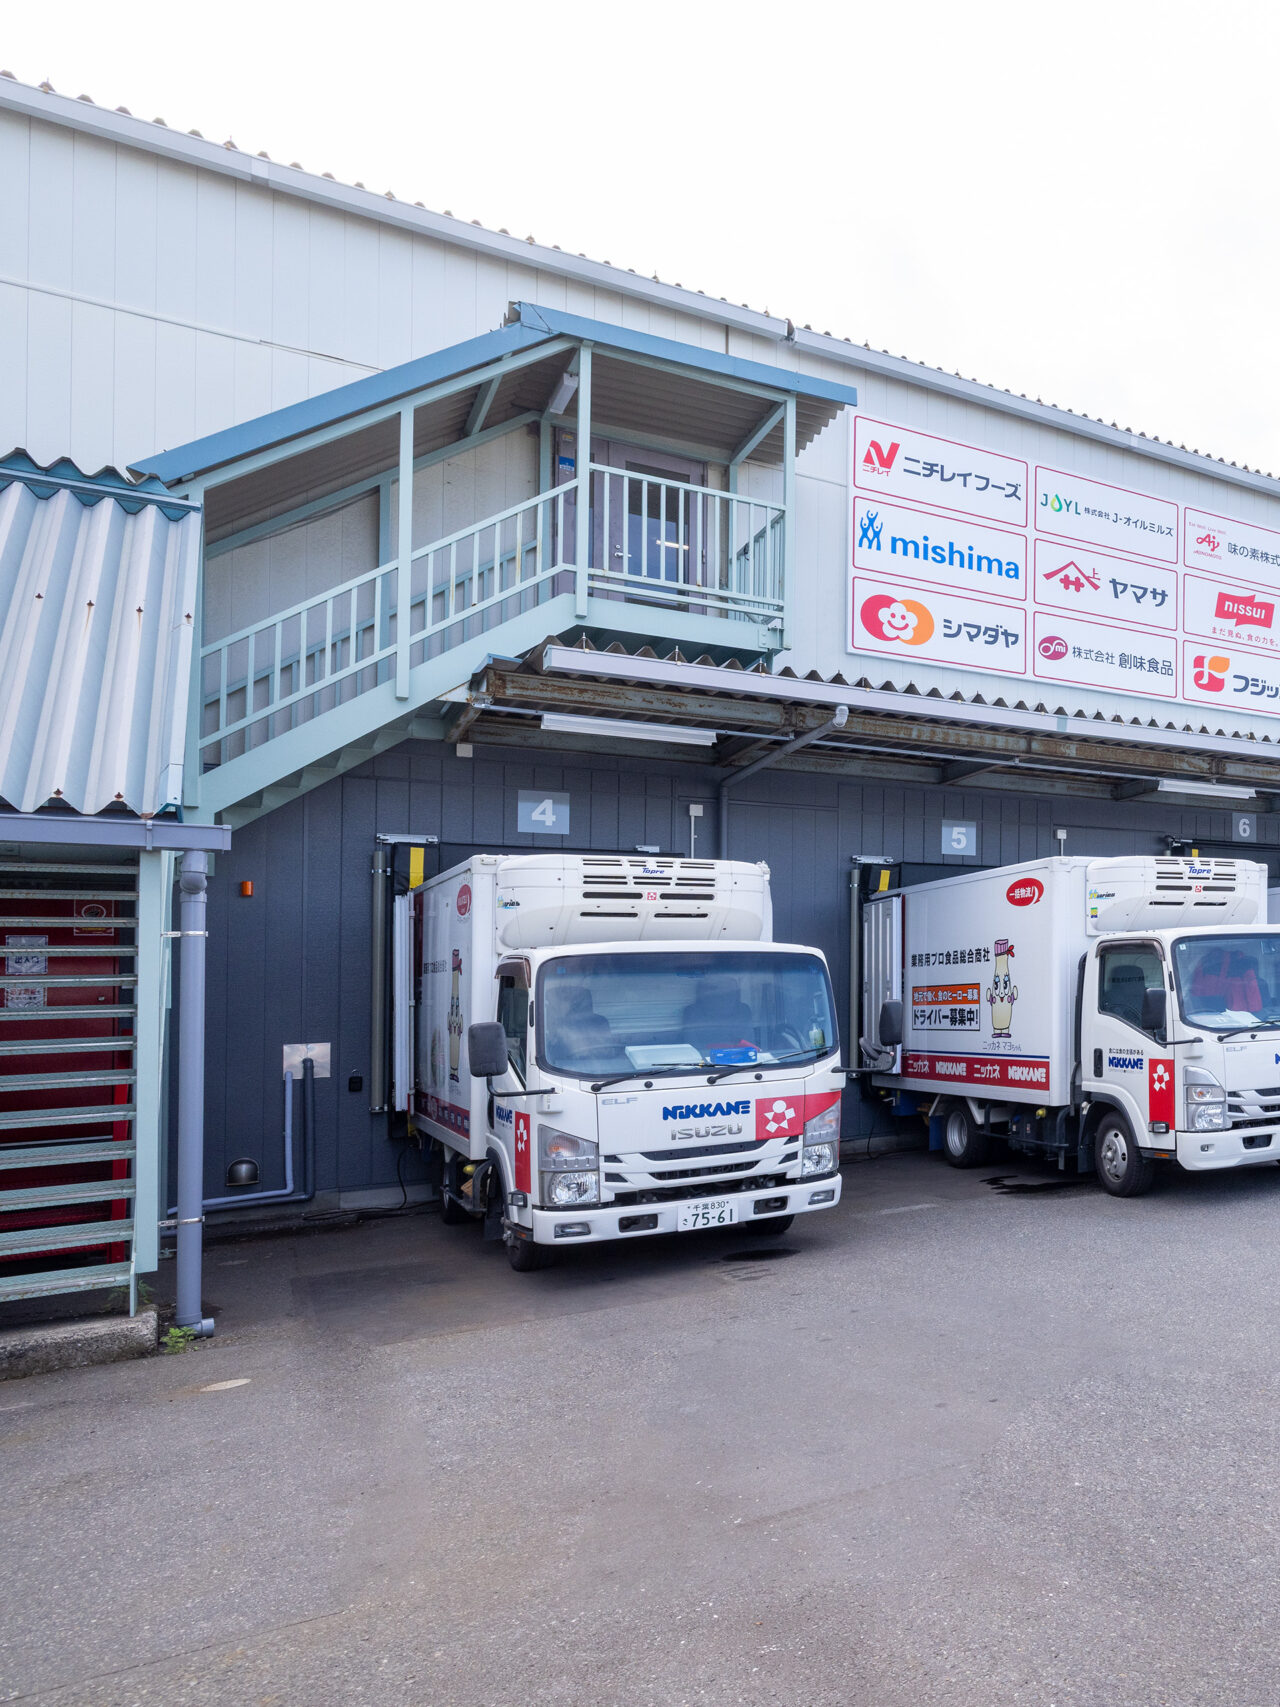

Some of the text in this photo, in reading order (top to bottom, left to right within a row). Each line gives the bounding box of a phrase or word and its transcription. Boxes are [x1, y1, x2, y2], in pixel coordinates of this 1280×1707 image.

[863, 464, 891, 476] ニチレイ
[903, 456, 1022, 501] ニチレイフーズ
[1084, 507, 1174, 537] 株式会社 J-オイルミルズ
[891, 535, 1020, 580] mishima
[1109, 578, 1168, 607] ヤマサ
[1224, 600, 1266, 619] nissui
[943, 618, 1020, 648] シマダヤ
[1072, 646, 1174, 676] 株式会社 創味食品
[531, 799, 557, 826] 4
[951, 826, 968, 850] 5
[1238, 817, 1250, 838] 6
[642, 867, 665, 875] Topre
[1188, 866, 1212, 875] Topre
[911, 946, 991, 968] 業務用プロ食品総合商社
[913, 1007, 979, 1027] ドライバー募集中!
[907, 1060, 1047, 1083] ニッカネ NIKKANE ニッカネ NIKKANE
[1108, 1056, 1144, 1070] NIKKANE
[601, 1097, 638, 1105] ELF
[662, 1100, 751, 1120] NIKKANE
[671, 1123, 743, 1141] ISUZU
[691, 1208, 733, 1228] 75-61
